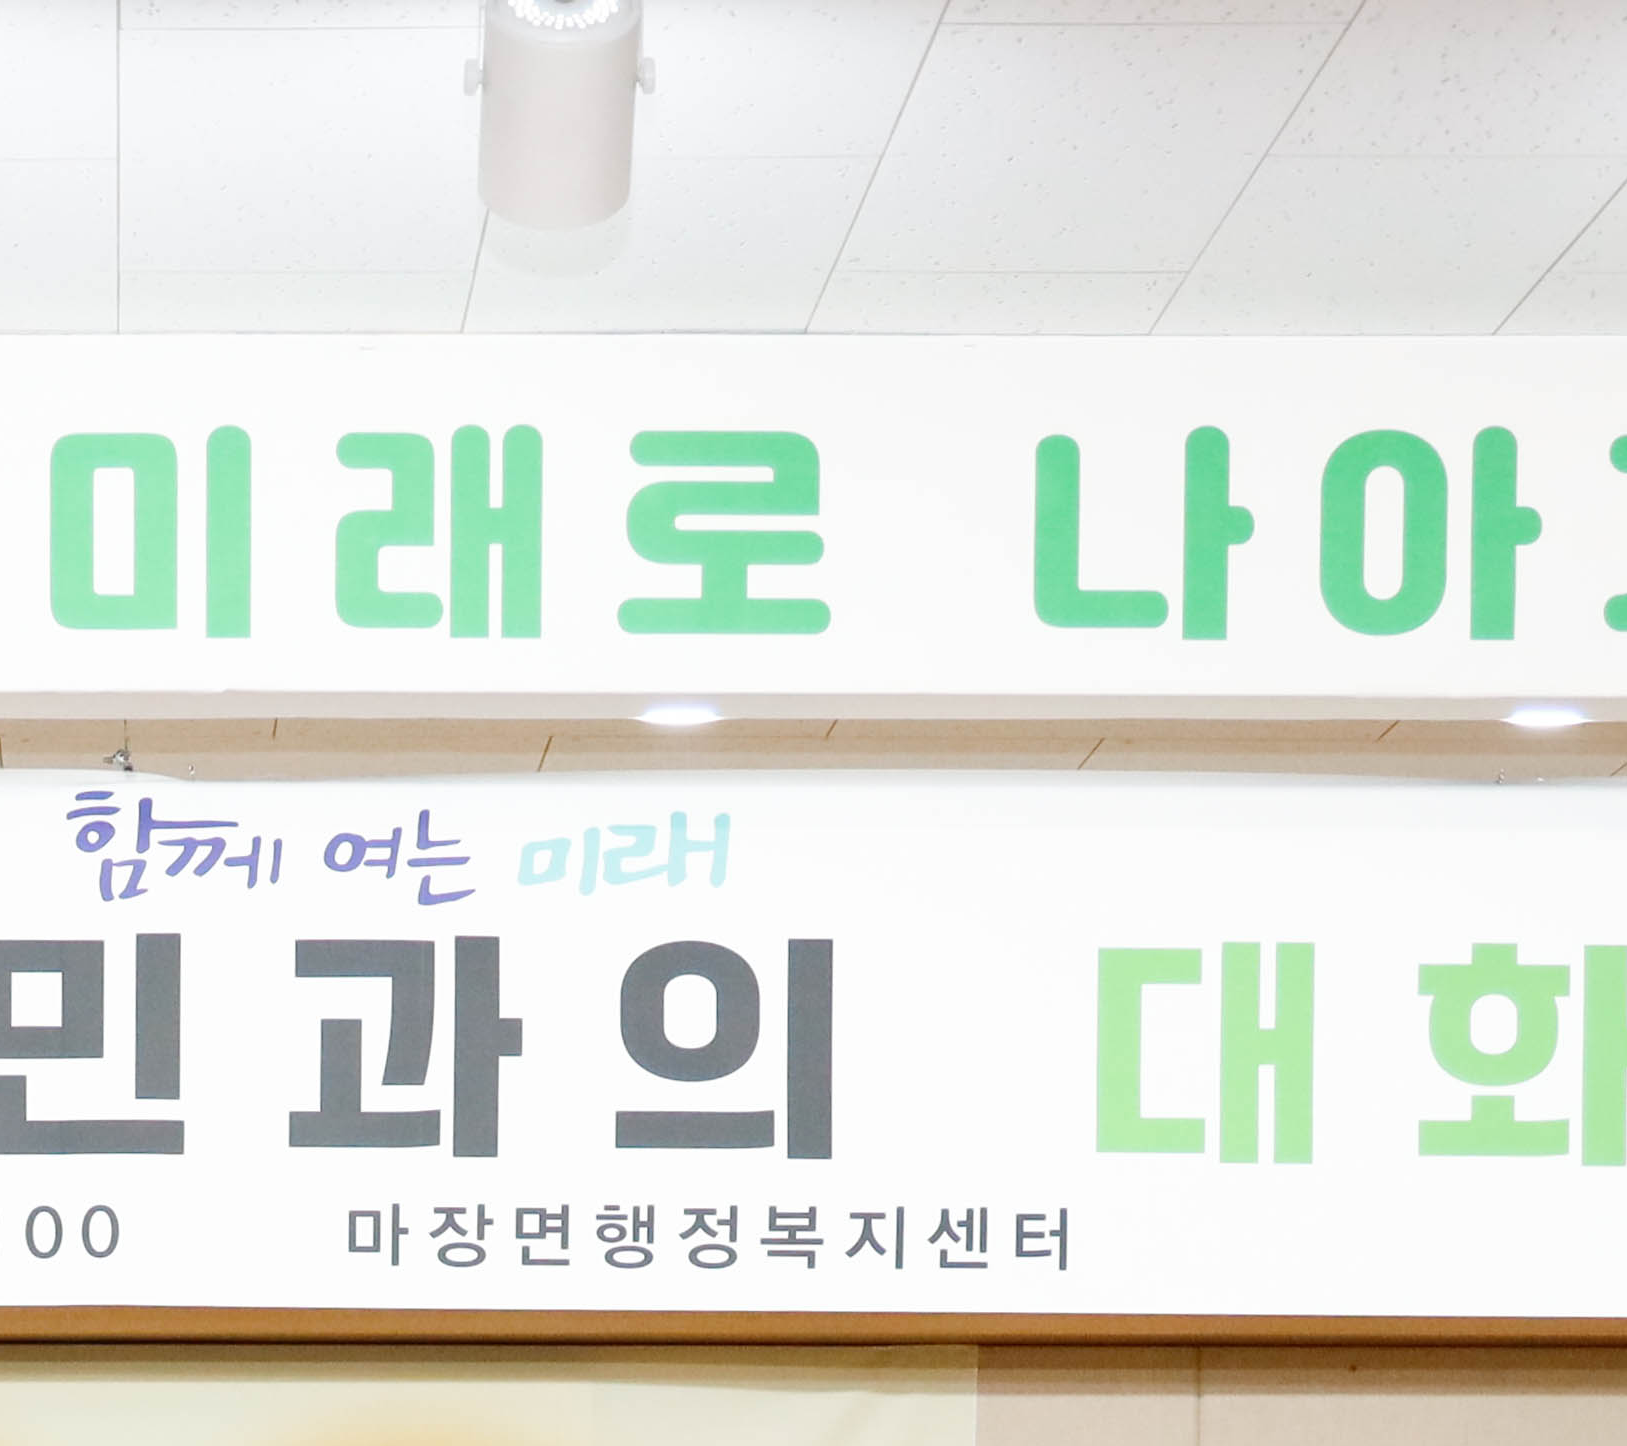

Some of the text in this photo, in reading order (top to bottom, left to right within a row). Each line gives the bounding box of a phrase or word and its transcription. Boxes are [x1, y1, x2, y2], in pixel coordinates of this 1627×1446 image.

[51, 425, 831, 639] 미래로
[67, 791, 283, 902] 함께
[323, 809, 475, 906] 여는
[517, 810, 732, 897] 미래
[348, 1202, 1072, 1271] 마장면행정복지센터
